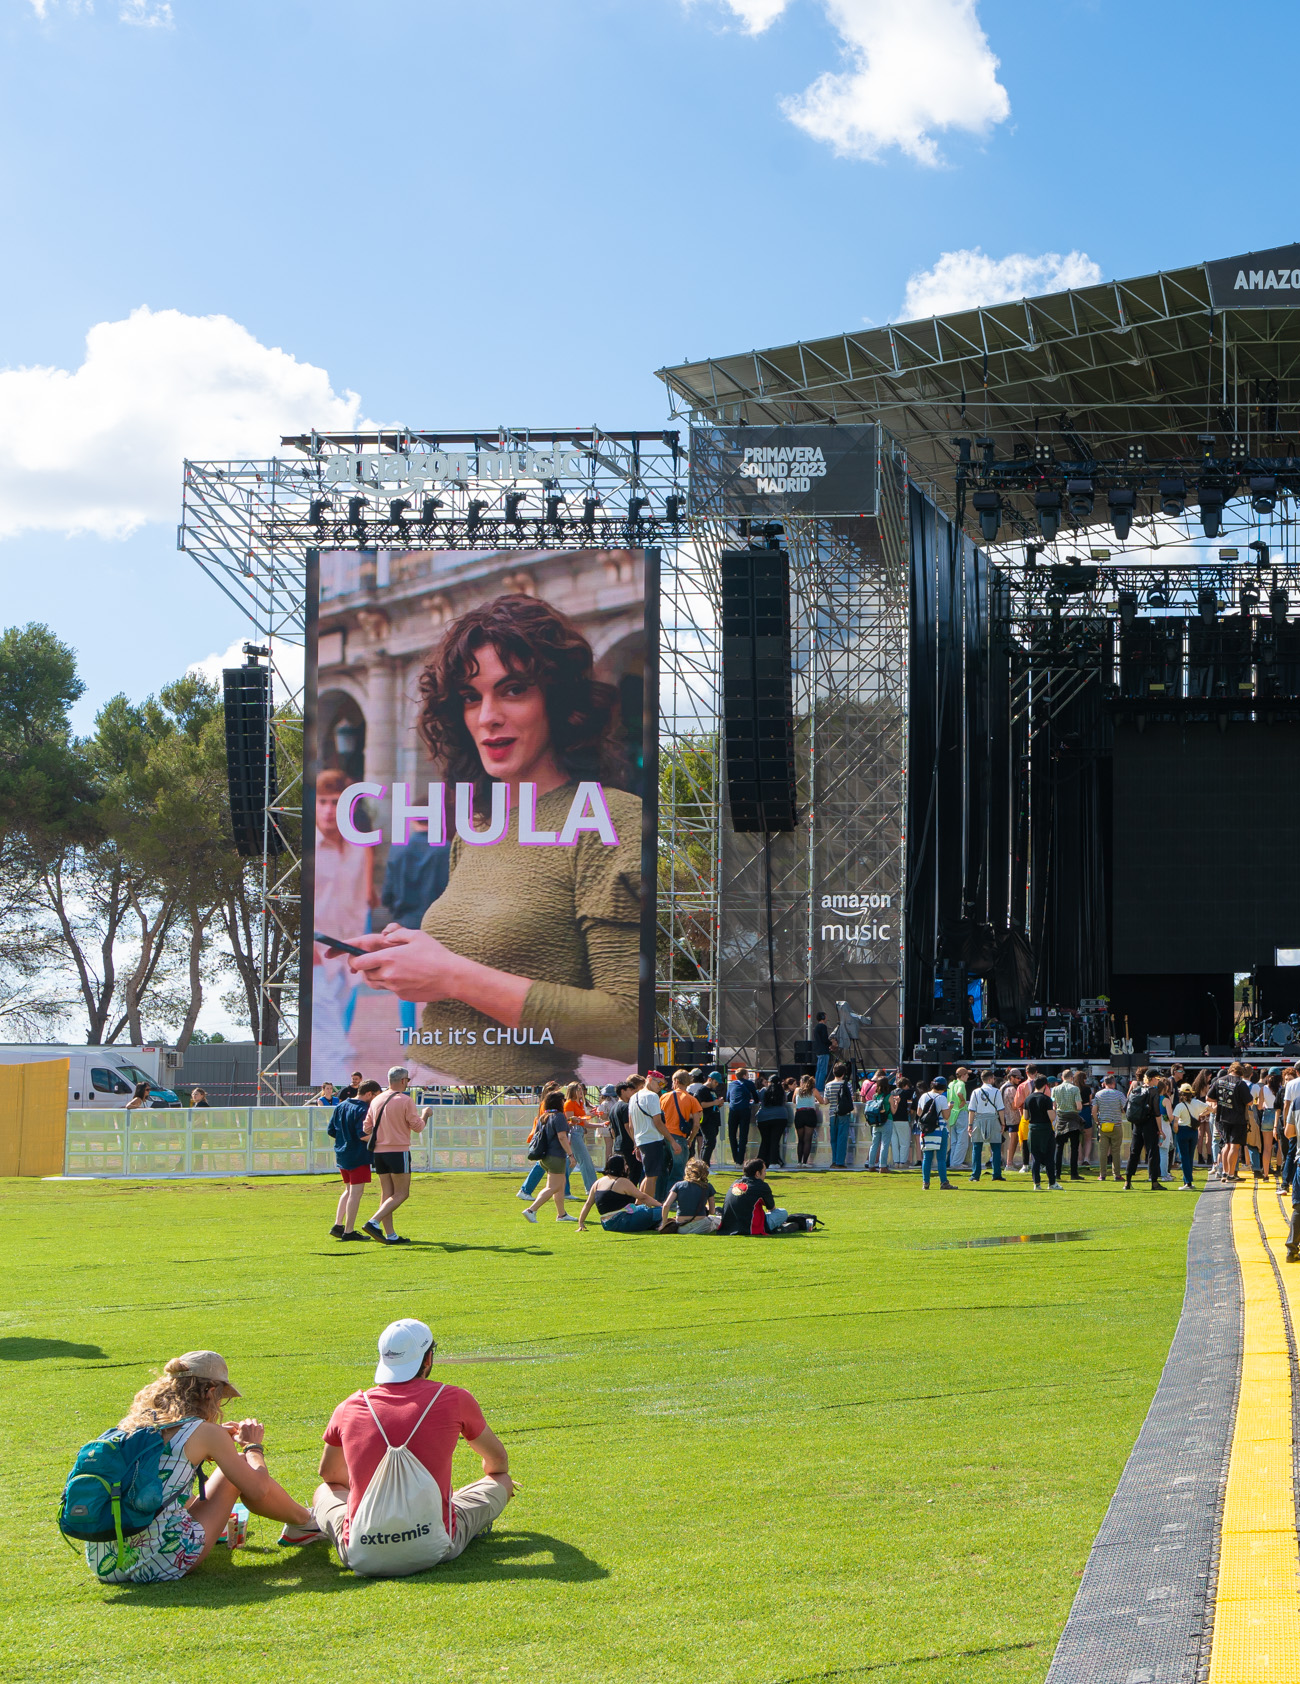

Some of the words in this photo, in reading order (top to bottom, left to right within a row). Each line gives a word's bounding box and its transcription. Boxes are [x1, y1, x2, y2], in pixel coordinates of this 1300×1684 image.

[325, 453, 469, 481] amazon
[479, 441, 582, 480] music
[744, 446, 824, 463] PRIMAVERA
[739, 462, 788, 478] SOUND
[790, 461, 827, 477] 2023
[757, 477, 811, 493] MADRID
[335, 781, 620, 847] CHULA
[821, 894, 891, 908] amazon
[821, 918, 891, 941] music
[395, 1027, 442, 1046] That
[482, 1027, 555, 1046] CHULA
[360, 1522, 431, 1546] extremis
